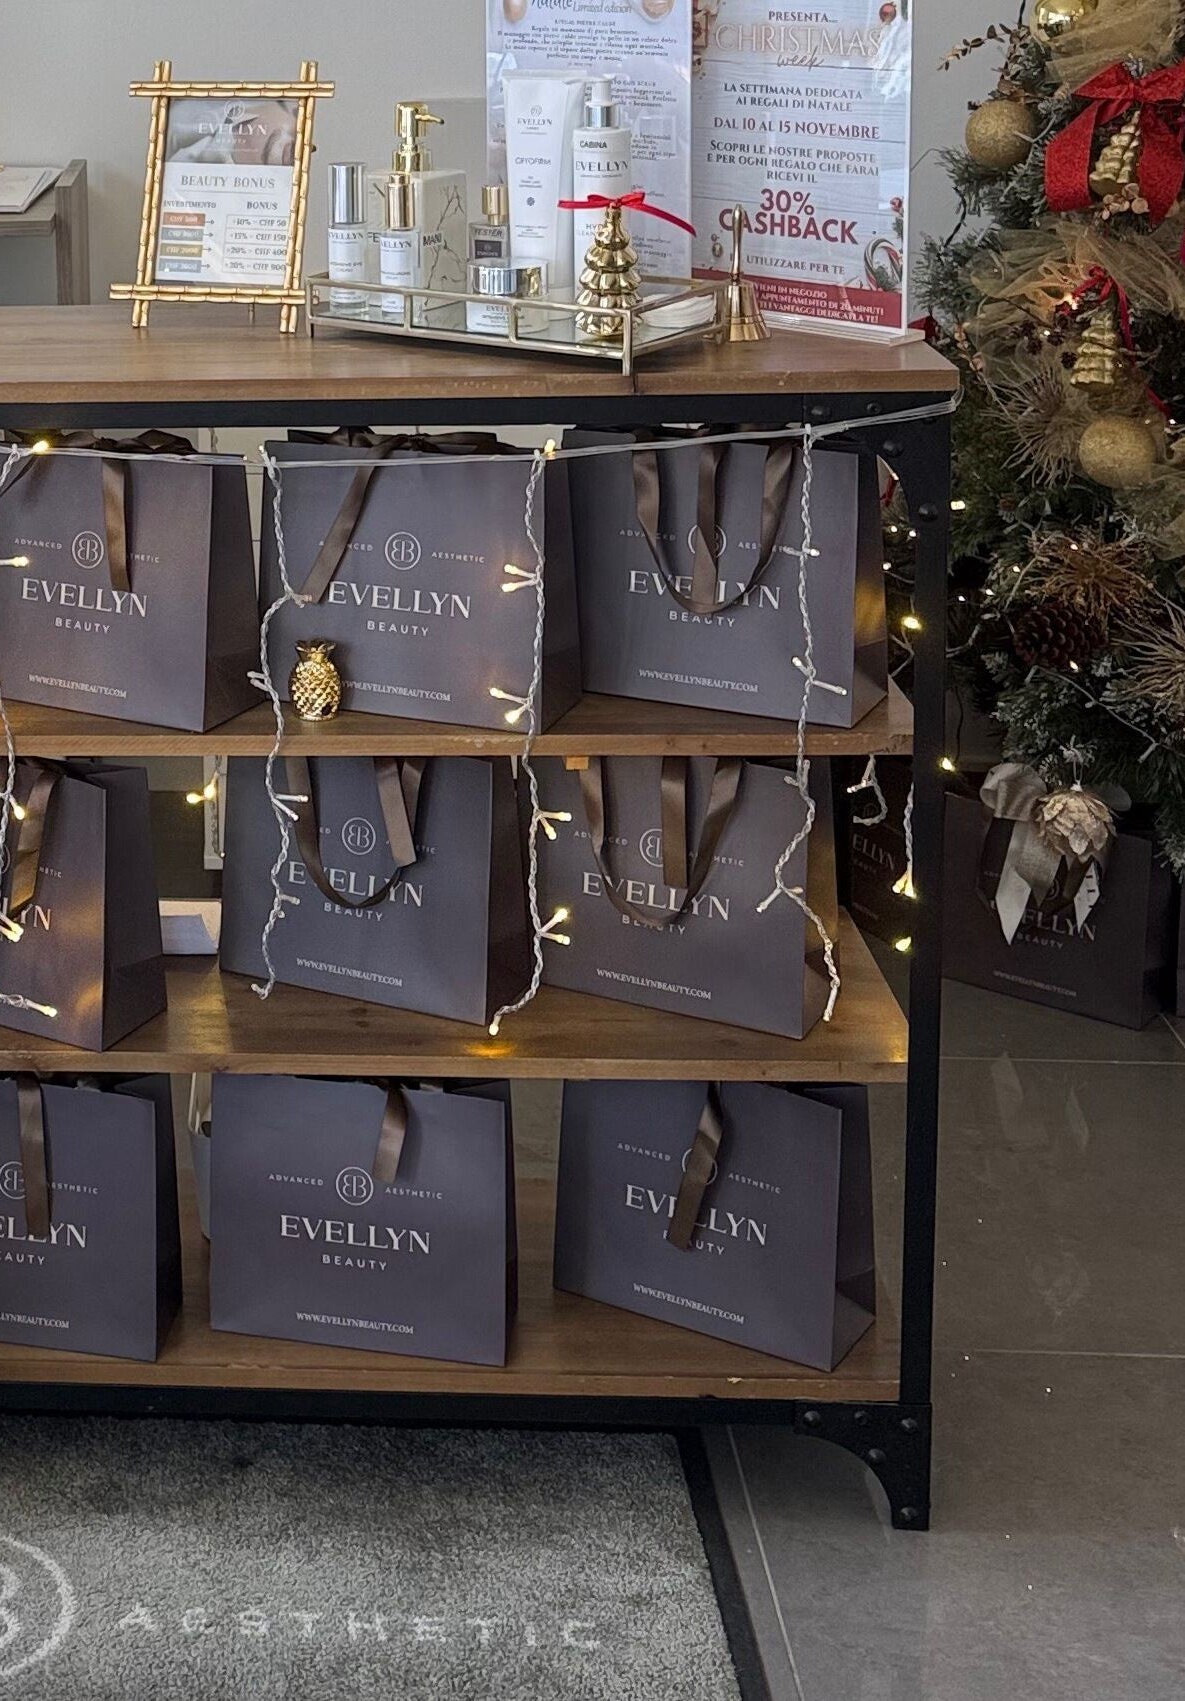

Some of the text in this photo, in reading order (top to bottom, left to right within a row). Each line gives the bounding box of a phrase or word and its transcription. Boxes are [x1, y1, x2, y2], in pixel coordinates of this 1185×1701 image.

[715, 22, 886, 58] CHRISTMAS
[777, 45, 825, 72] week
[724, 82, 863, 100] LA SETTIMANA DEDICATA
[735, 96, 853, 113] AI REGALI DI NATALE
[198, 122, 269, 136] EVELLYN
[714, 117, 881, 140] DAL 10 AL 15 NOVEMBRE
[579, 140, 608, 149] CABINA
[753, 143, 766, 154] LE
[767, 144, 813, 160] NOSTRE
[816, 148, 877, 164] PROPOSTE
[575, 160, 629, 172] EVELLYN
[706, 152, 880, 177] E PER OGNI REGALO CHE FARAI
[180, 174, 275, 190] BEAUTY BONUS
[766, 170, 818, 184] RICEVI IL
[246, 201, 279, 211] BONUS
[759, 187, 815, 216] 30%
[259, 219, 275, 227] CHF
[255, 232, 272, 241] CHF
[254, 248, 271, 256] CHF
[252, 263, 269, 271] CHF
[746, 255, 845, 276] UTILIZZARE PER TE
[788, 286, 827, 299] NEGOZIO
[760, 291, 827, 308] APPUNTAMENTO
[852, 304, 884, 316] MINUTI
[14, 537, 64, 550] ADVANCED
[430, 551, 486, 564] AESTHETIC
[21, 577, 148, 618] EVELLYN
[327, 580, 472, 620] EVELLYN
[54, 616, 112, 635] BEAUTY
[366, 619, 430, 637] BEAUTY
[28, 673, 127, 699] WWW.EVELLYNBEAUTY.COM
[638, 668, 759, 694] WWW.EVELLYNBEAUTY.COM
[323, 901, 384, 923] BEAUTY
[295, 956, 403, 988] WWW.EVELLYNBEAUTY.COM
[595, 968, 712, 1000] WWW.EVELLYNBEAUTY.COM
[617, 1142, 672, 1162] ADVANCED
[268, 1172, 325, 1186] ADVANCED
[727, 1172, 782, 1195] AESTHETIC
[384, 1186, 443, 1200] AESTHETIC
[280, 1213, 431, 1255] EVELLYN
[321, 1253, 388, 1271] BEAUTY
[633, 1282, 746, 1325] WWW.EVELLYNBEAUTY.COM
[295, 1311, 415, 1335] WWW.EVELLYNBEAUTY.COM
[117, 1602, 602, 1650] AESTHETIC
